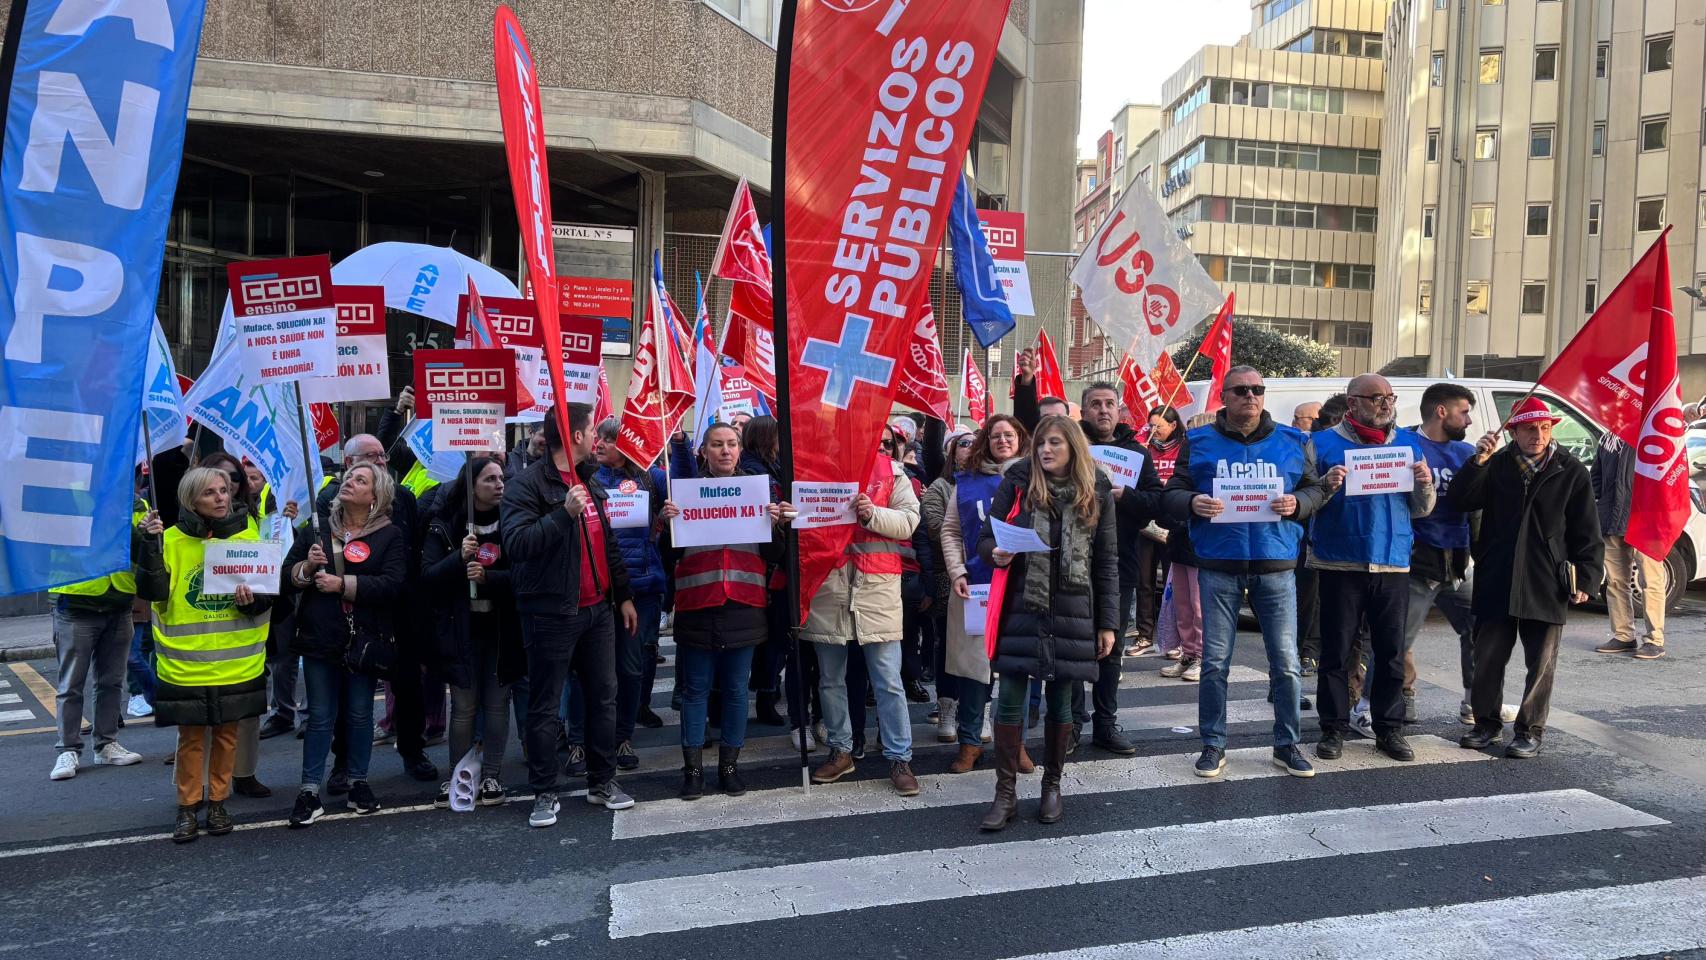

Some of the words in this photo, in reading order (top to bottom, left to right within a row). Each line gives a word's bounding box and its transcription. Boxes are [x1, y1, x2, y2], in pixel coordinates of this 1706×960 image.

[825, 36, 928, 308] SERVIZOS
[869, 40, 975, 319] PÚBLICOS
[606, 231, 612, 239] 5
[242, 276, 322, 304] CCOO
[406, 264, 439, 312] ANPE
[245, 301, 297, 316] ensino
[335, 304, 374, 323] OO
[276, 317, 311, 330] SOLUCIÓN
[313, 317, 326, 325] XA!
[247, 338, 252, 347] A
[255, 335, 277, 346] NOSA
[307, 329, 325, 340] NON
[280, 348, 301, 359] UNHA
[337, 345, 358, 356] ace
[358, 364, 373, 376] XA
[376, 363, 381, 375] !
[426, 368, 505, 390] CCOO
[1597, 375, 1630, 400] sindicato
[427, 390, 479, 402] ensino
[193, 406, 241, 440] SINDICATO
[199, 385, 291, 489] ANPE
[1103, 449, 1129, 462] Muface
[1123, 467, 1133, 478] XA
[1375, 472, 1390, 480] UNHA
[700, 485, 742, 498] Muface
[683, 504, 739, 521] SOLUCIÓN
[741, 506, 756, 518] XA
[759, 505, 763, 517] !
[226, 549, 259, 559] Muface
[212, 563, 254, 575] SOLUCIÓN
[256, 565, 268, 574] XA
[271, 565, 275, 574] !
